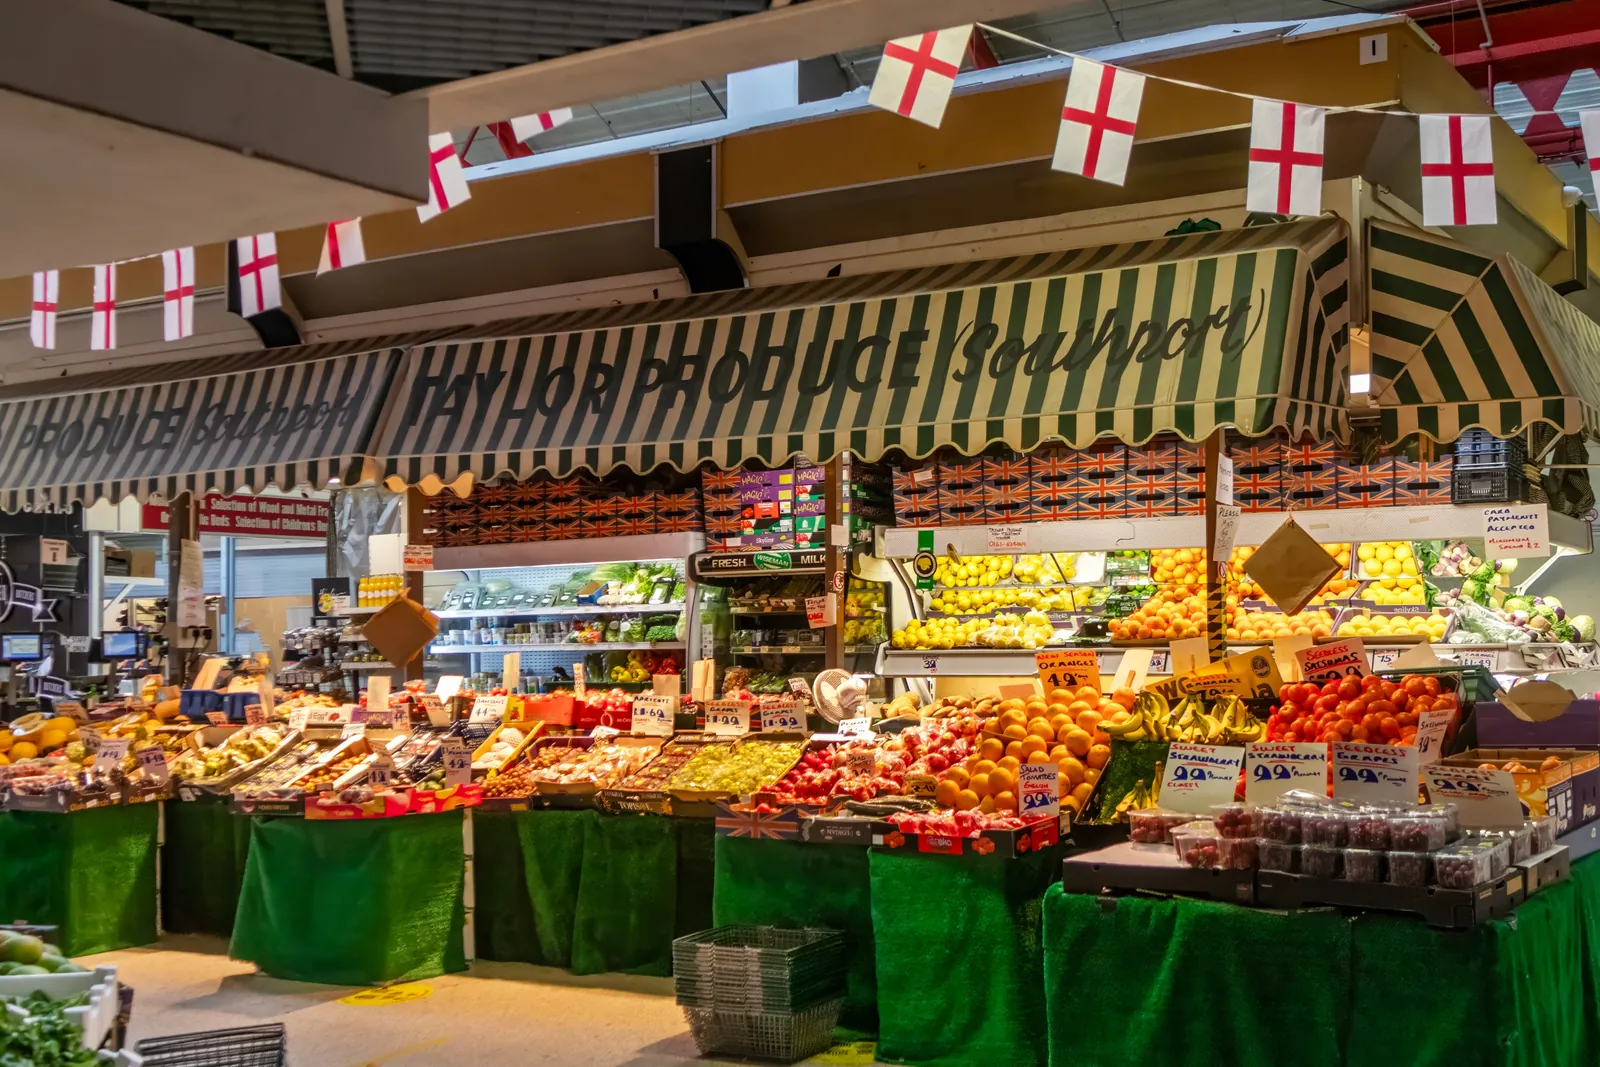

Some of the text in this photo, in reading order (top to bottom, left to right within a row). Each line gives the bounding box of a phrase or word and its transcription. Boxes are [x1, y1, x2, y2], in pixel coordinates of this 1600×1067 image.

[634, 329, 930, 410] PRODUCE
[20, 406, 186, 459] PRODUCE
[797, 468, 819, 482] MAGIC
[741, 489, 764, 502] MAGIC
[248, 499, 257, 513] of
[281, 503, 294, 515] and
[797, 501, 819, 514] MAGIC
[272, 518, 281, 530] of
[756, 537, 774, 545] Skyline
[712, 554, 826, 568] FRESH MILK
[757, 554, 789, 567] WISEMAN
[1306, 645, 1348, 660] SEEDLESS
[1039, 660, 1094, 669] ORANGES
[1305, 652, 1358, 672] SATSUMAS
[1171, 744, 1216, 753] SWEET
[1335, 744, 1406, 757] SEEDLESS
[1169, 752, 1240, 767] STRAWBERRY
[1248, 753, 1325, 761] STRAWBERRY
[1337, 752, 1398, 764] GRAPES
[1019, 764, 1044, 774] SALAD
[1020, 772, 1056, 780] TOMATOES
